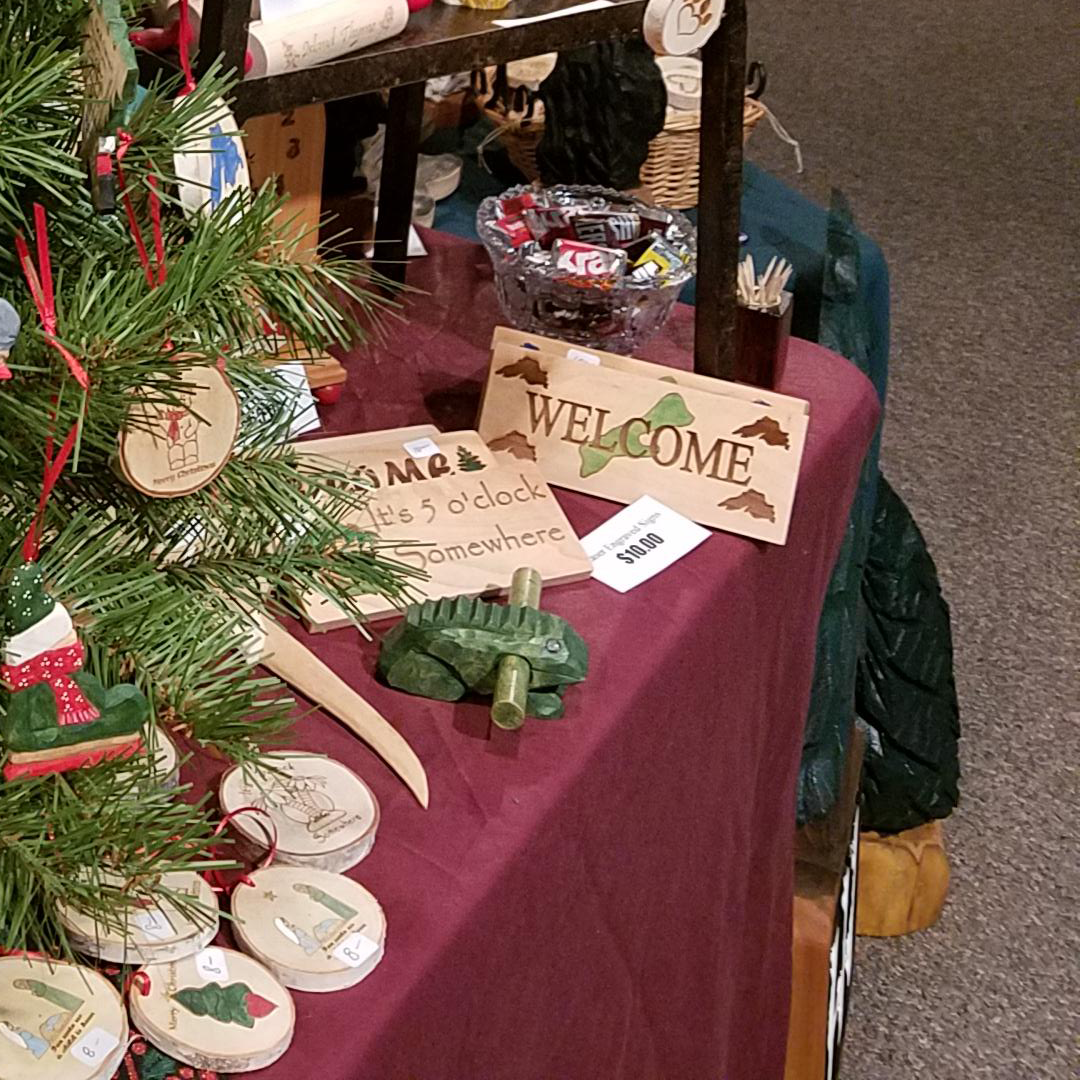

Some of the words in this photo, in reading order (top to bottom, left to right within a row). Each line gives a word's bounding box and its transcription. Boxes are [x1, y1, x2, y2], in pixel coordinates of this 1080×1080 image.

[525, 390, 756, 487] WELCOME
[421, 498, 436, 524] 5
[447, 473, 548, 515] o'clock
[393, 522, 566, 572] Somewhere
[616, 532, 665, 565] $10.00
